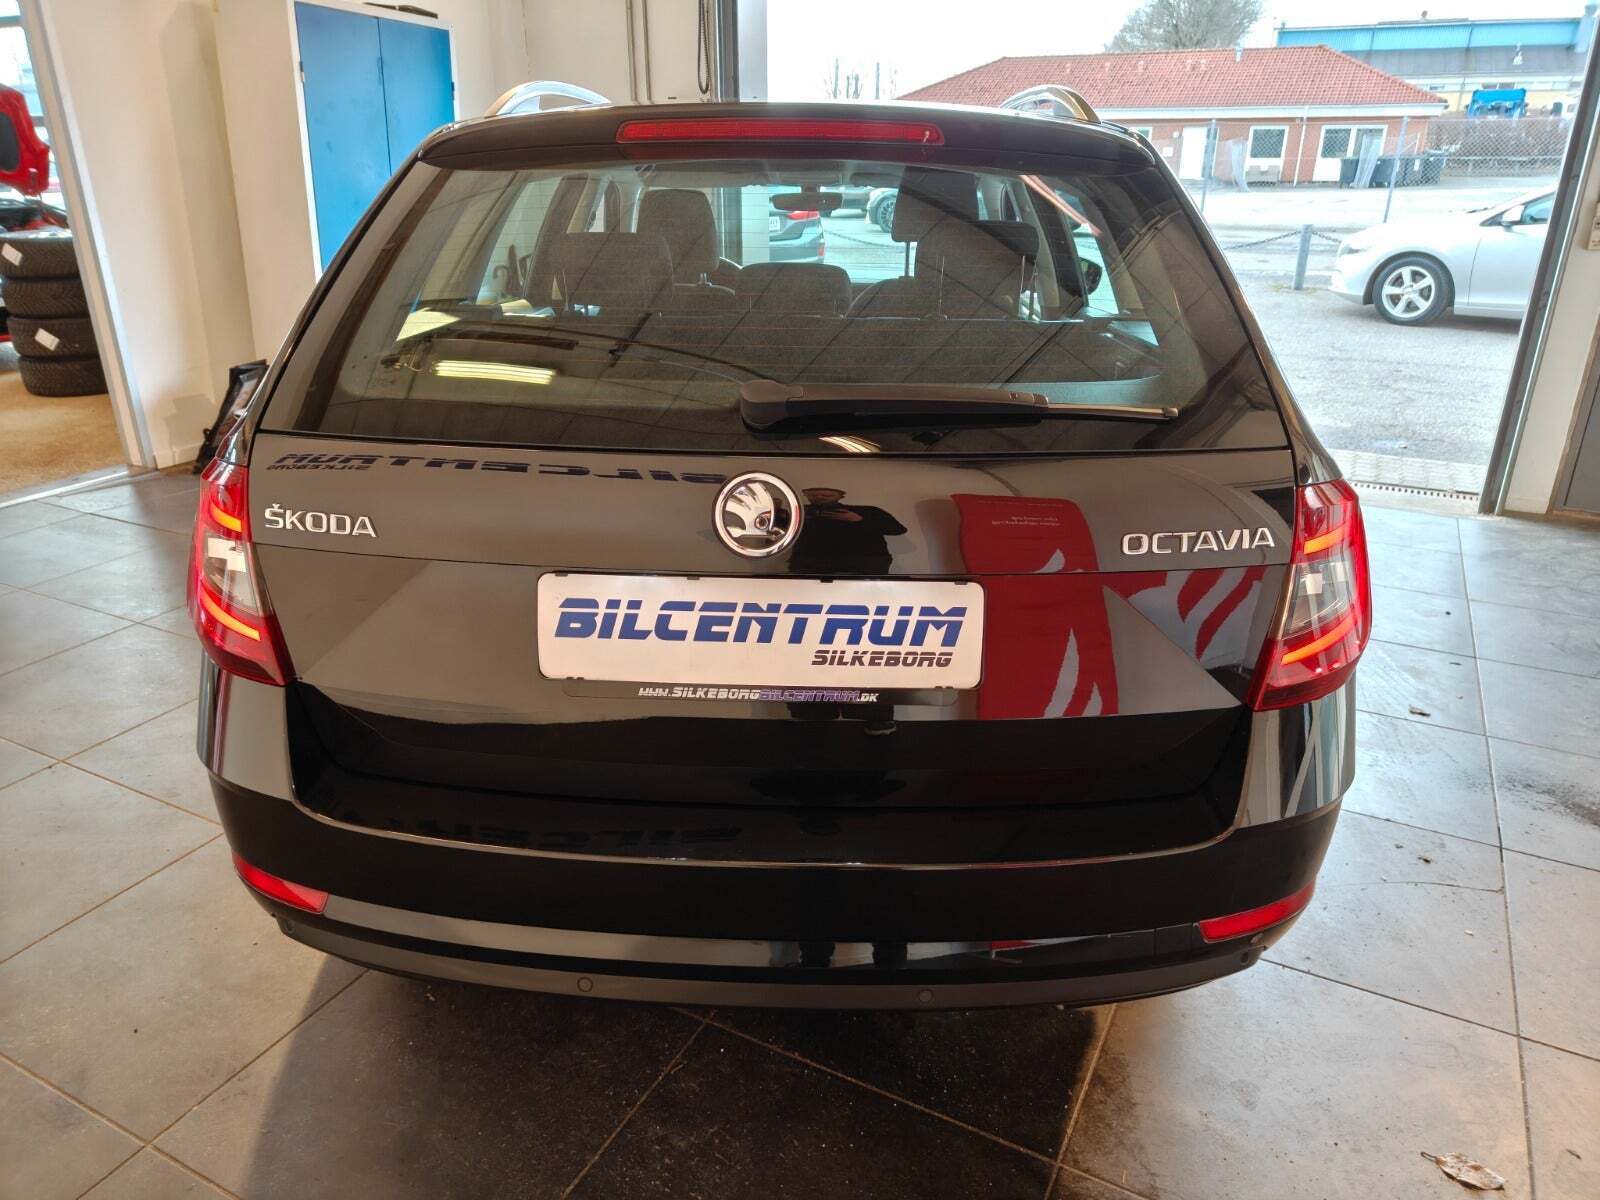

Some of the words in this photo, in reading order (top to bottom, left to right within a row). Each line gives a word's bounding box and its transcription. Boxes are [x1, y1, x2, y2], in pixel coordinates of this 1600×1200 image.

[264, 503, 377, 538] ŠKODA
[1121, 527, 1276, 555] OCTAVIA
[554, 597, 968, 647] BILCENTRUM
[811, 649, 953, 669] SILKEBORG
